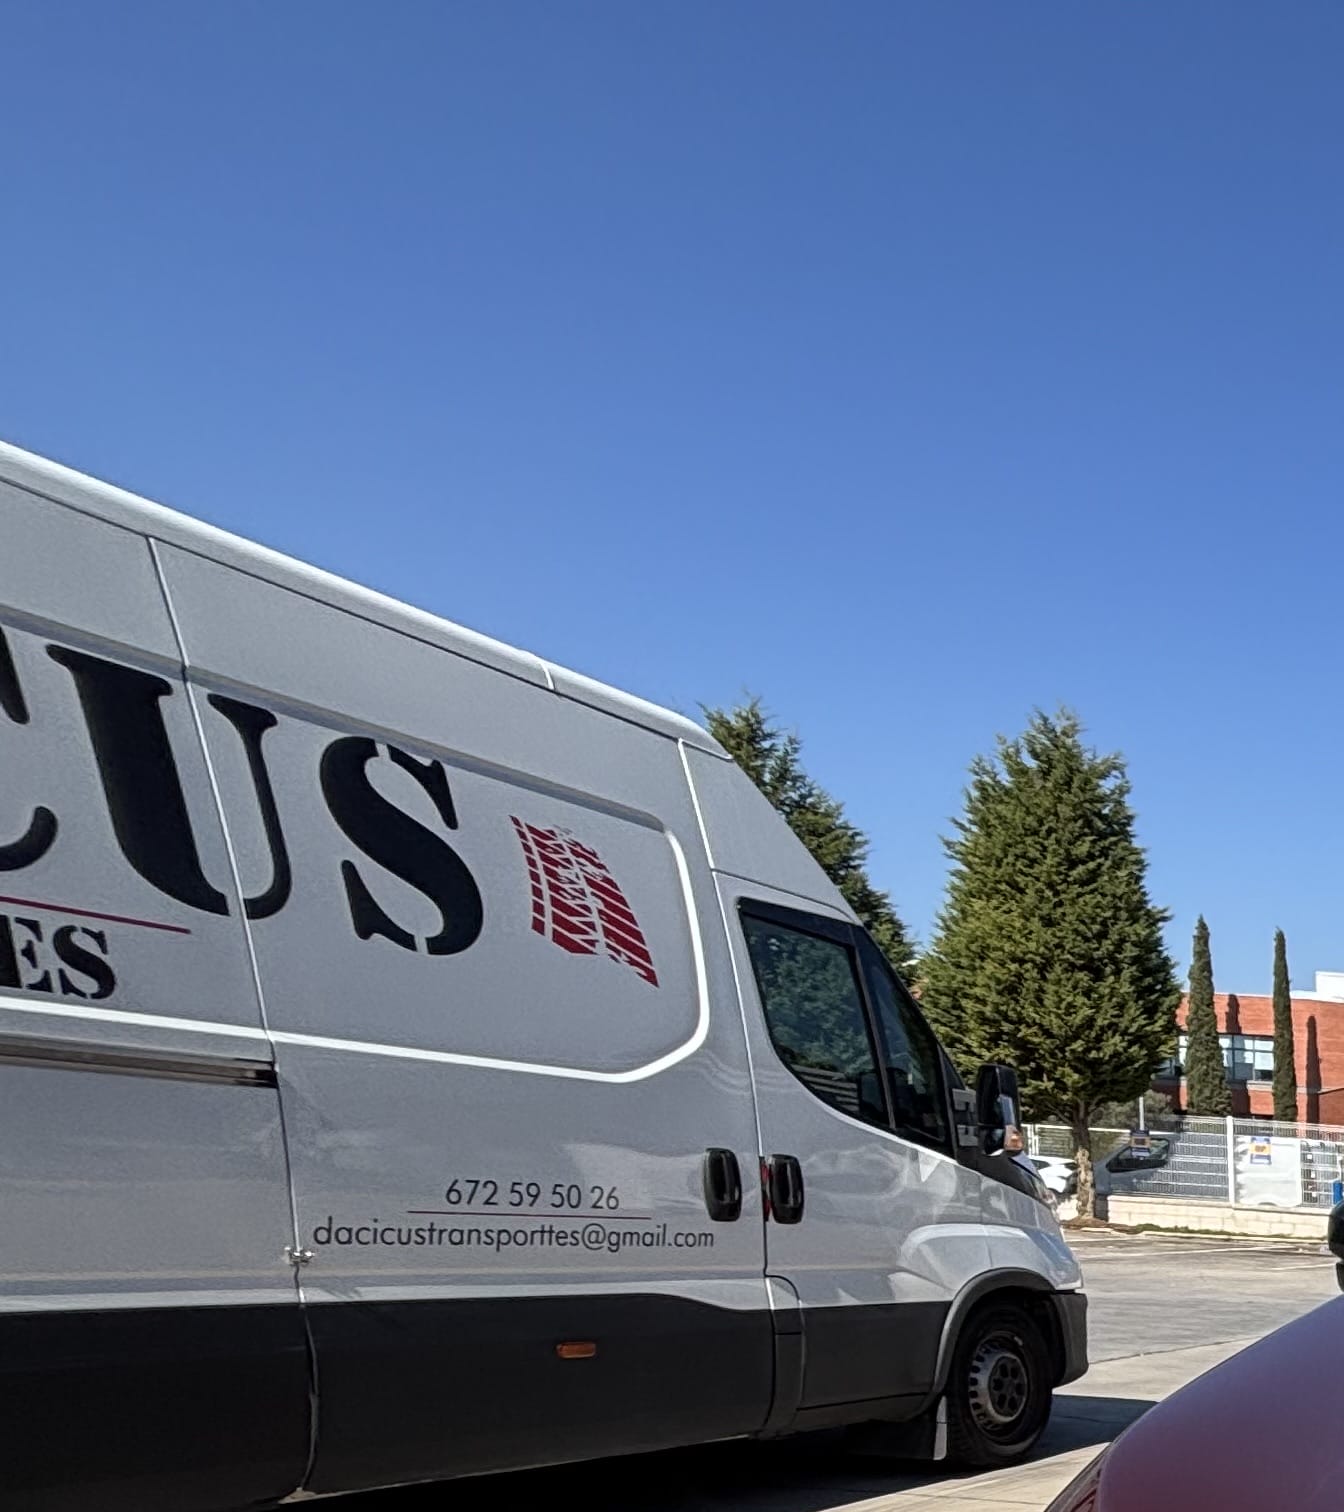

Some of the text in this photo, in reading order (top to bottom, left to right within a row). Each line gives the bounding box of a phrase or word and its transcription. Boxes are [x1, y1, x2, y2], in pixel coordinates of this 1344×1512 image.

[445, 1179, 620, 1210] 672 59 50 26
[313, 1215, 714, 1253] dacicustransporttes@gmail.com
